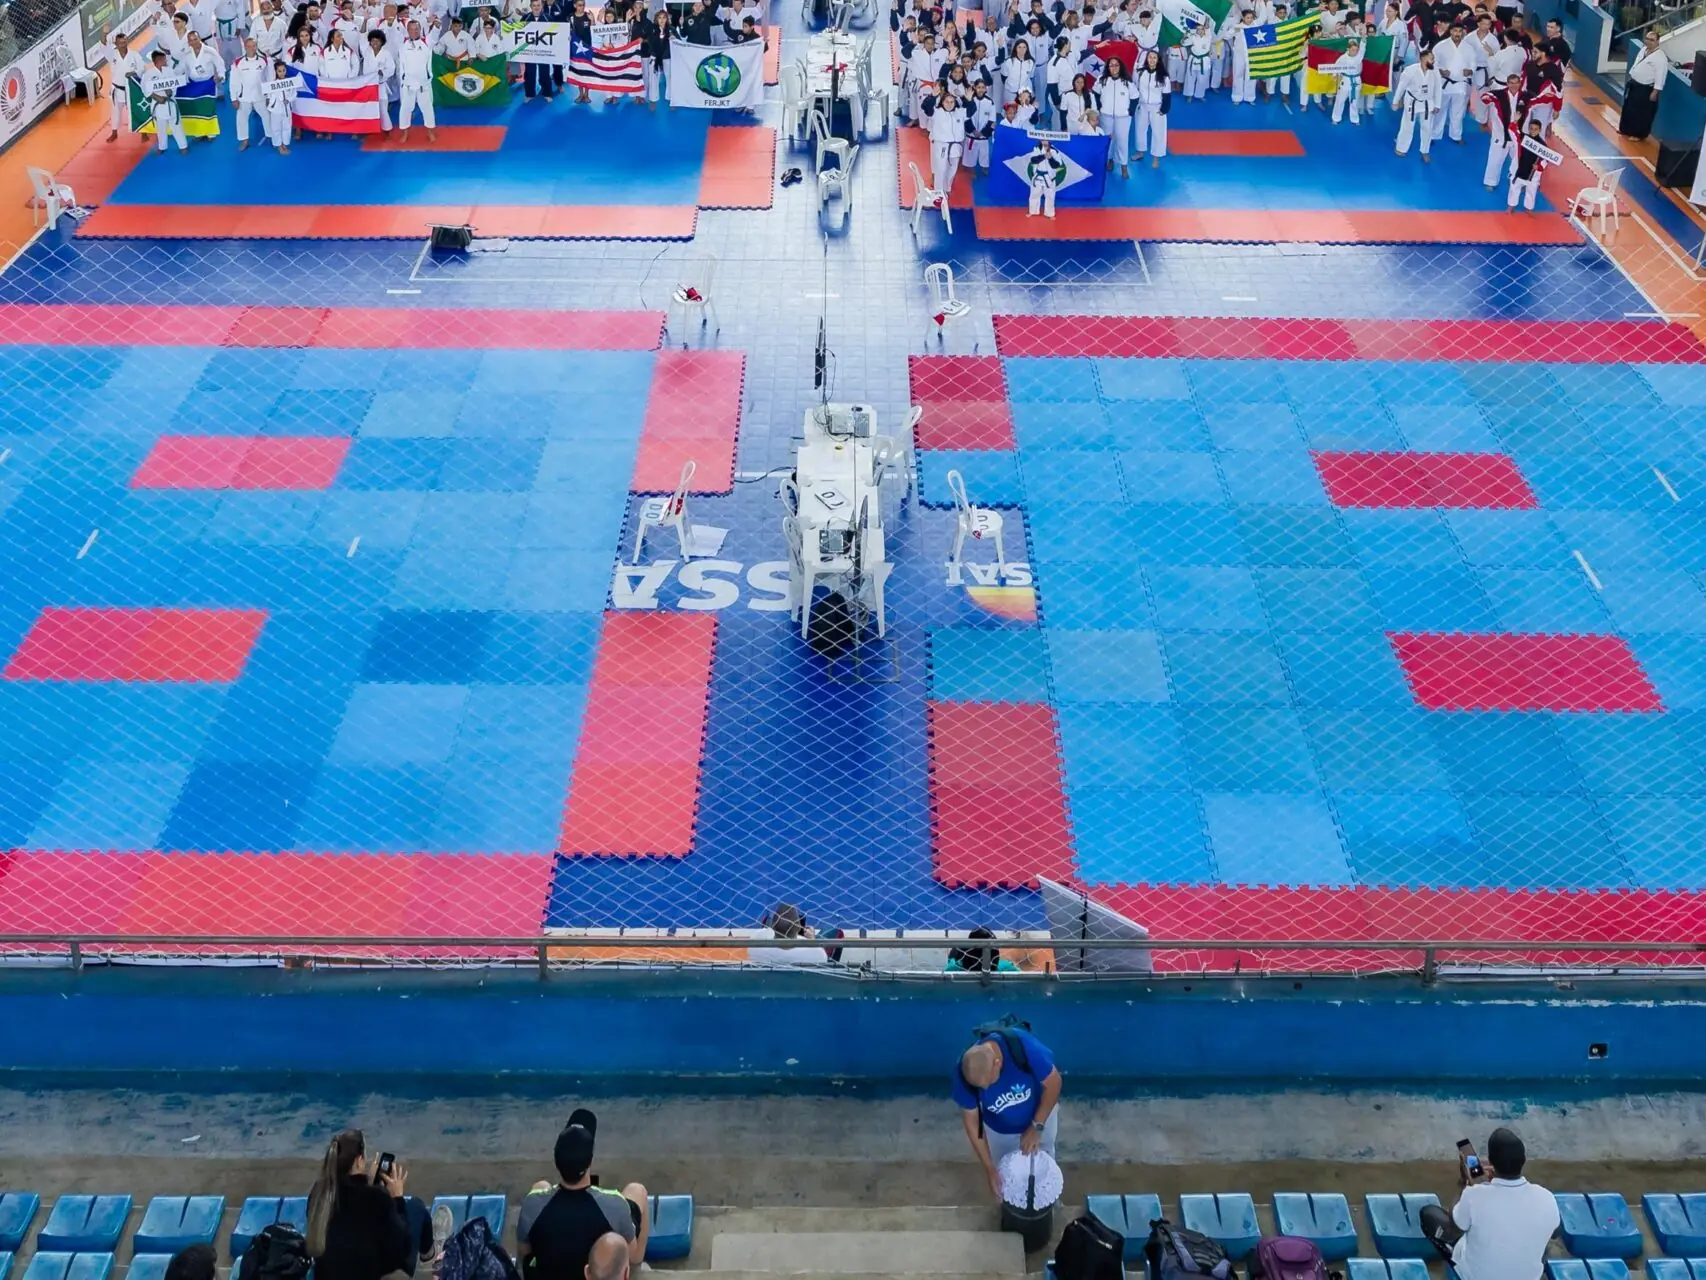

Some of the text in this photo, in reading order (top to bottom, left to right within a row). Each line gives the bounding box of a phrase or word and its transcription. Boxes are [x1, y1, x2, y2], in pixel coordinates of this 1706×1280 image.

[514, 30, 558, 46] FGKT
[270, 79, 294, 91] BAHIA
[1525, 139, 1559, 162] SÃO PAULO
